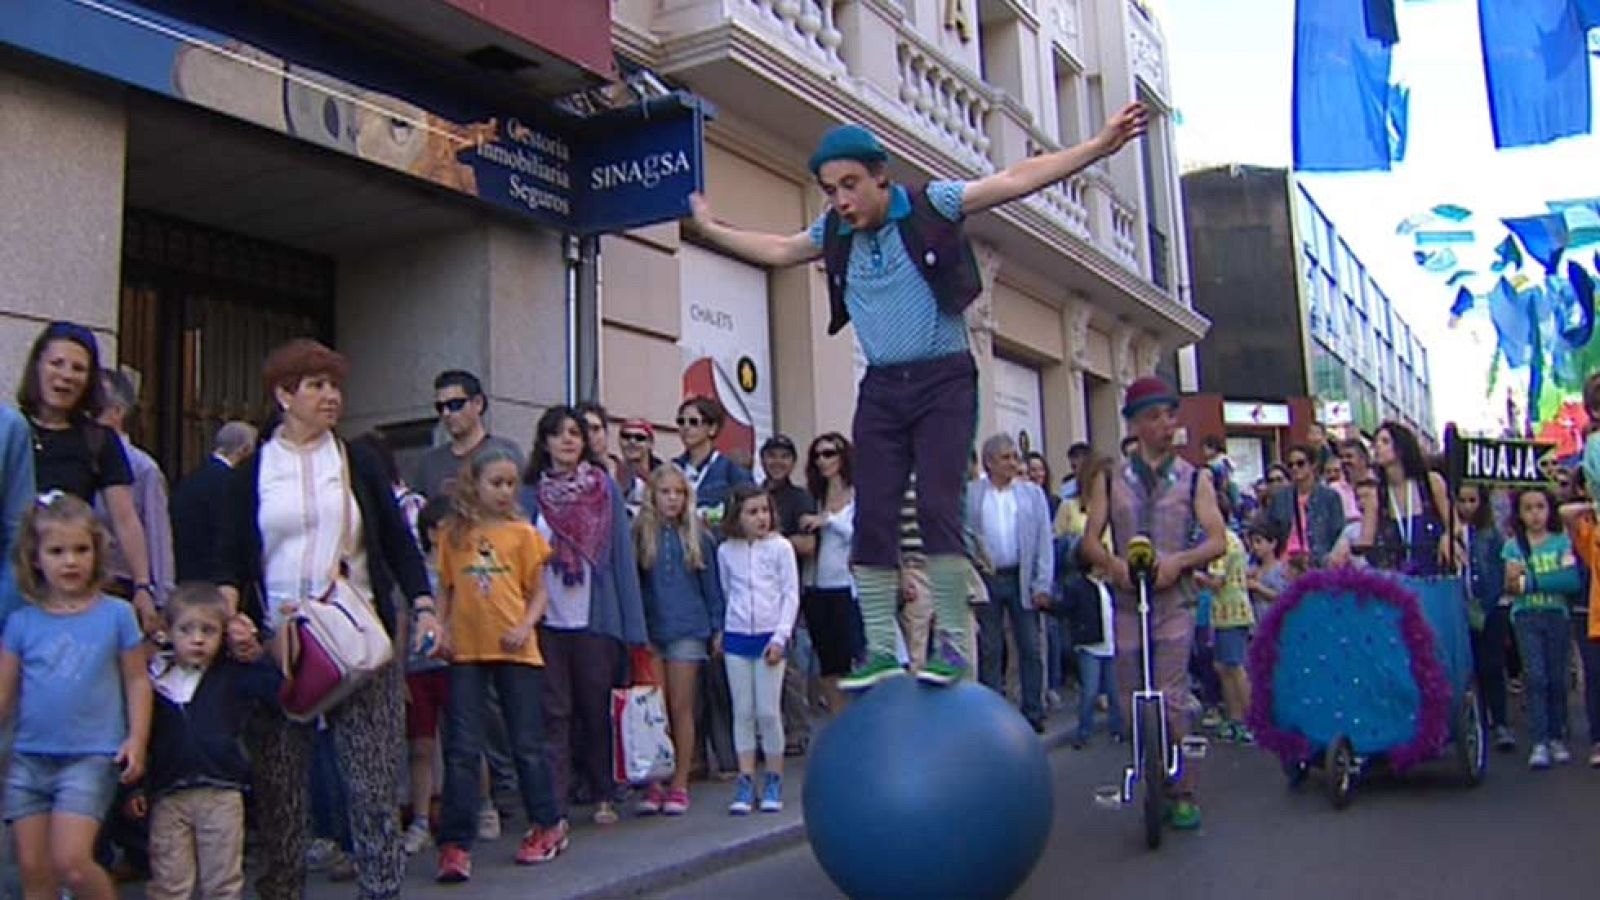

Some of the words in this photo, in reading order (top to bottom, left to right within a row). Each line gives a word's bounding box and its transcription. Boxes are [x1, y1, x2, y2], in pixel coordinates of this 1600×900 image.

[510, 173, 570, 215] Seguros
[690, 304, 734, 332] CHALETS
[1467, 442, 1537, 479] HUAJA
